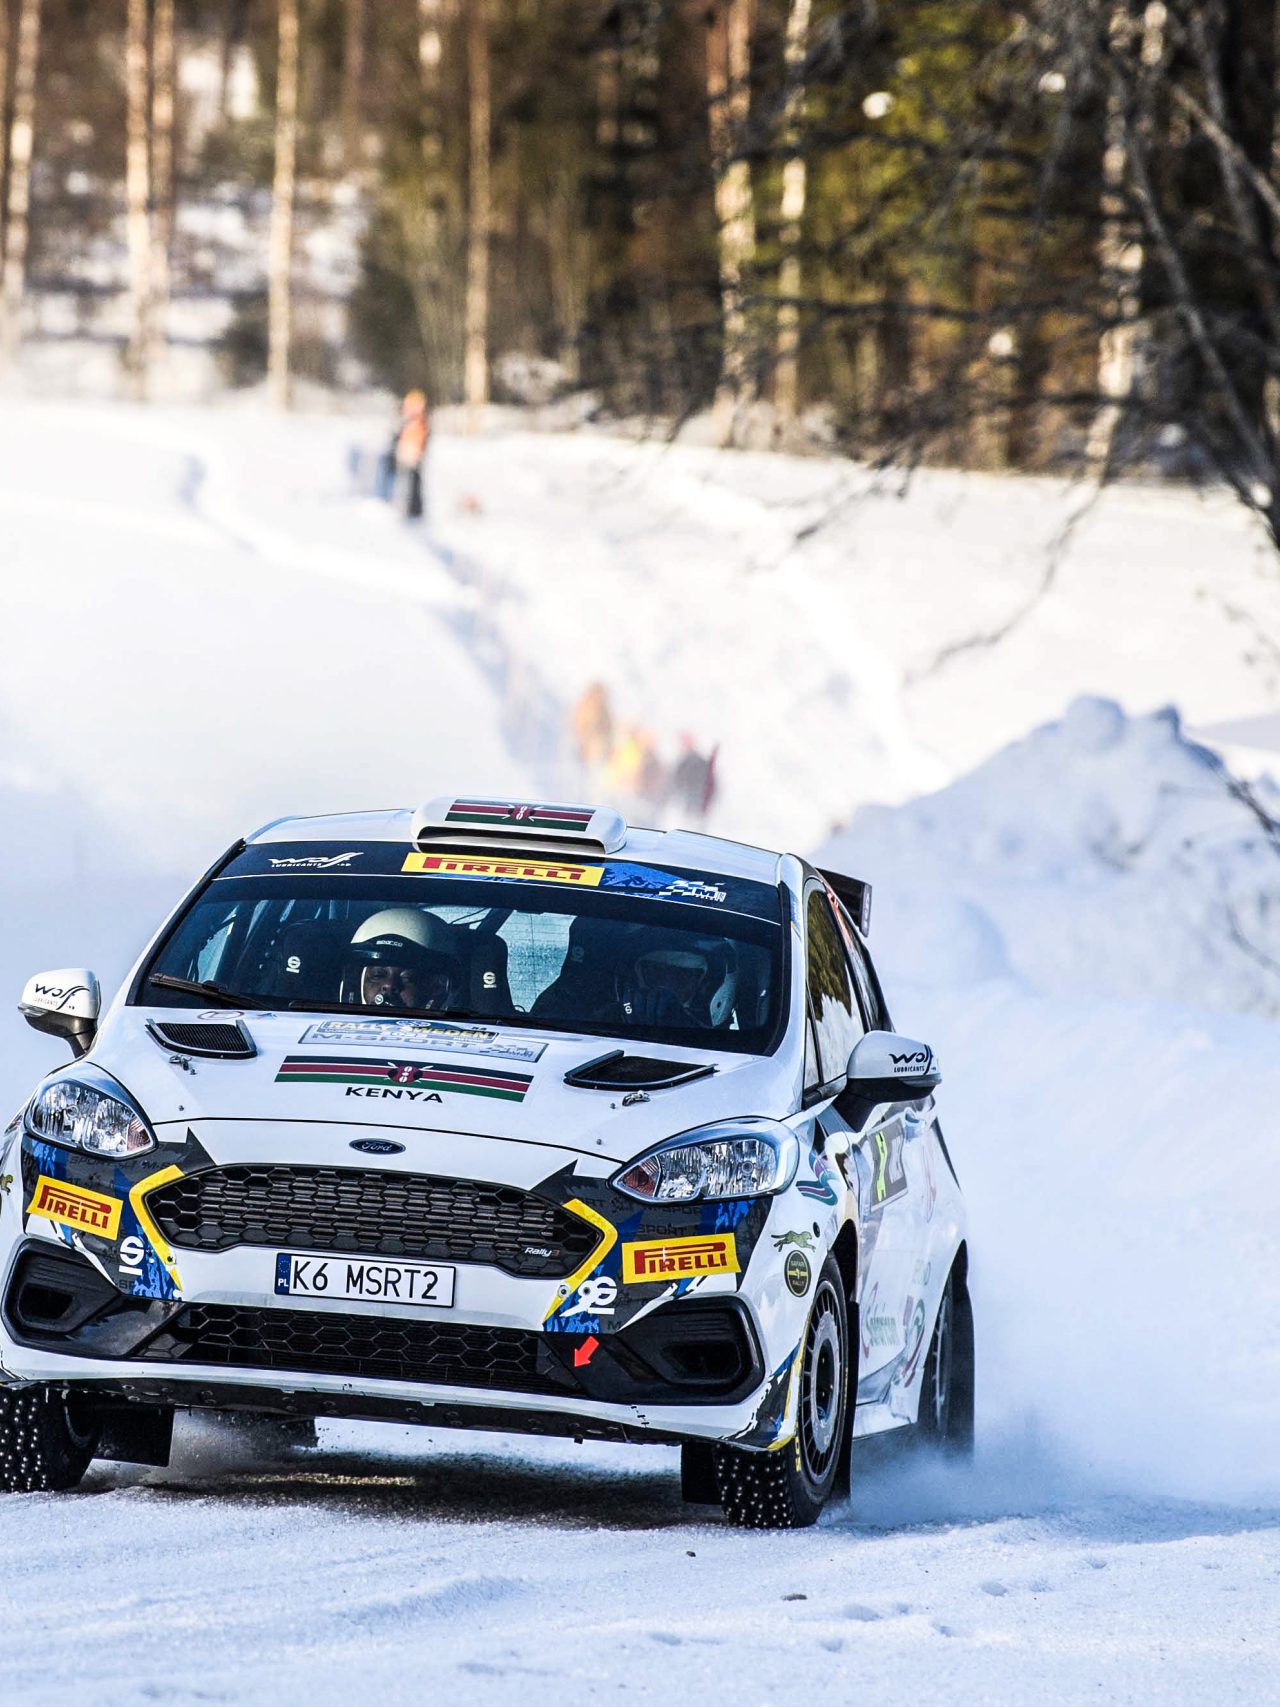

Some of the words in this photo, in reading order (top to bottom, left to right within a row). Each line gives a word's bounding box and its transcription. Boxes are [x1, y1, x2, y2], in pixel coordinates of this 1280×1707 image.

[422, 856, 586, 881] PIRELLI
[894, 1065, 925, 1073] LUBRICANTS
[345, 1086, 443, 1104] KENYA
[360, 1141, 393, 1152] Ford
[37, 1184, 112, 1230] PIRELLI
[634, 1241, 728, 1275] PIRELLI
[277, 1278, 289, 1288] PL
[293, 1260, 329, 1292] K6
[346, 1264, 439, 1300] MSRT2
